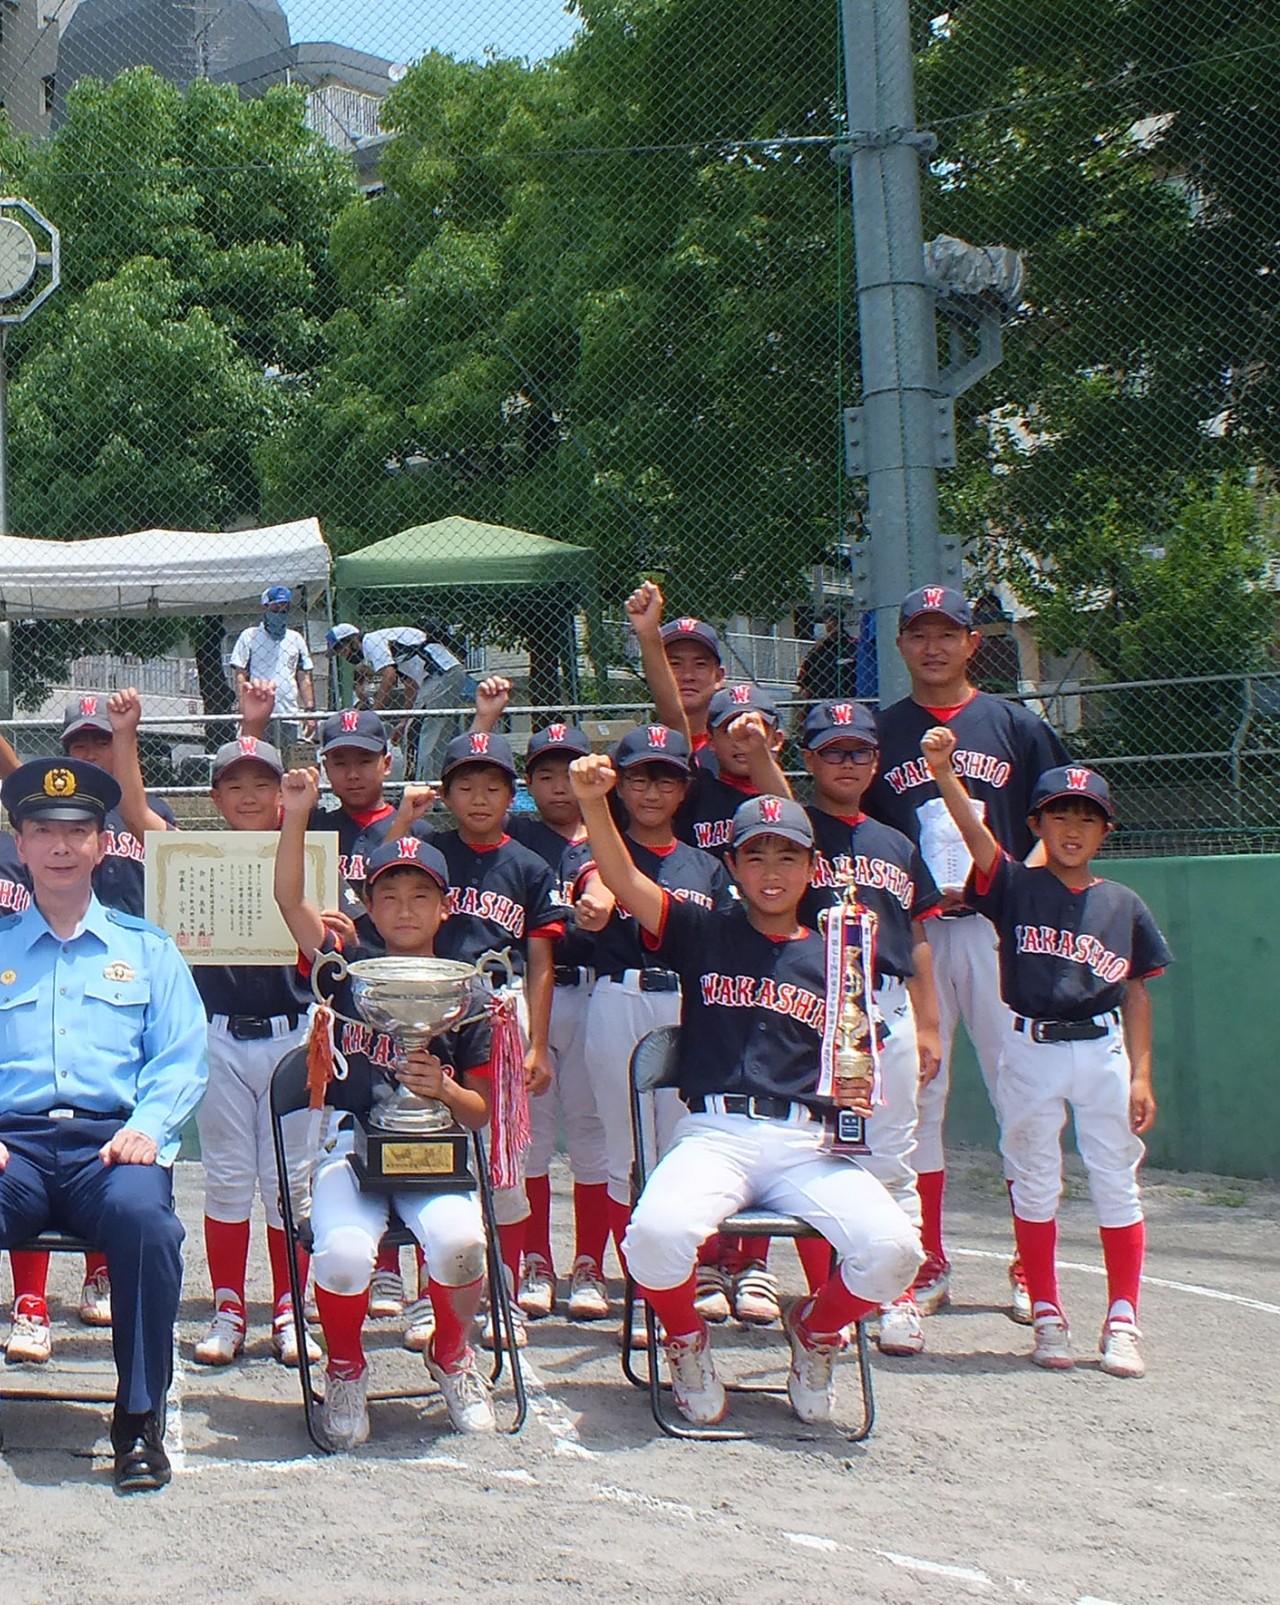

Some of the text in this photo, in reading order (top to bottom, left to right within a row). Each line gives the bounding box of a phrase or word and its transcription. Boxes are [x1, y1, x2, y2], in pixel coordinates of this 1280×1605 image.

[922, 587, 945, 608] W
[677, 616, 698, 633] W
[80, 695, 97, 716] W
[730, 685, 751, 704] W
[341, 710, 359, 732] W
[831, 703, 853, 726] W
[470, 732, 490, 754] W
[547, 723, 567, 742] W
[646, 725, 668, 748] W
[238, 736, 258, 756] W
[1064, 768, 1091, 791] W
[759, 798, 782, 823] W
[396, 836, 420, 859] W
